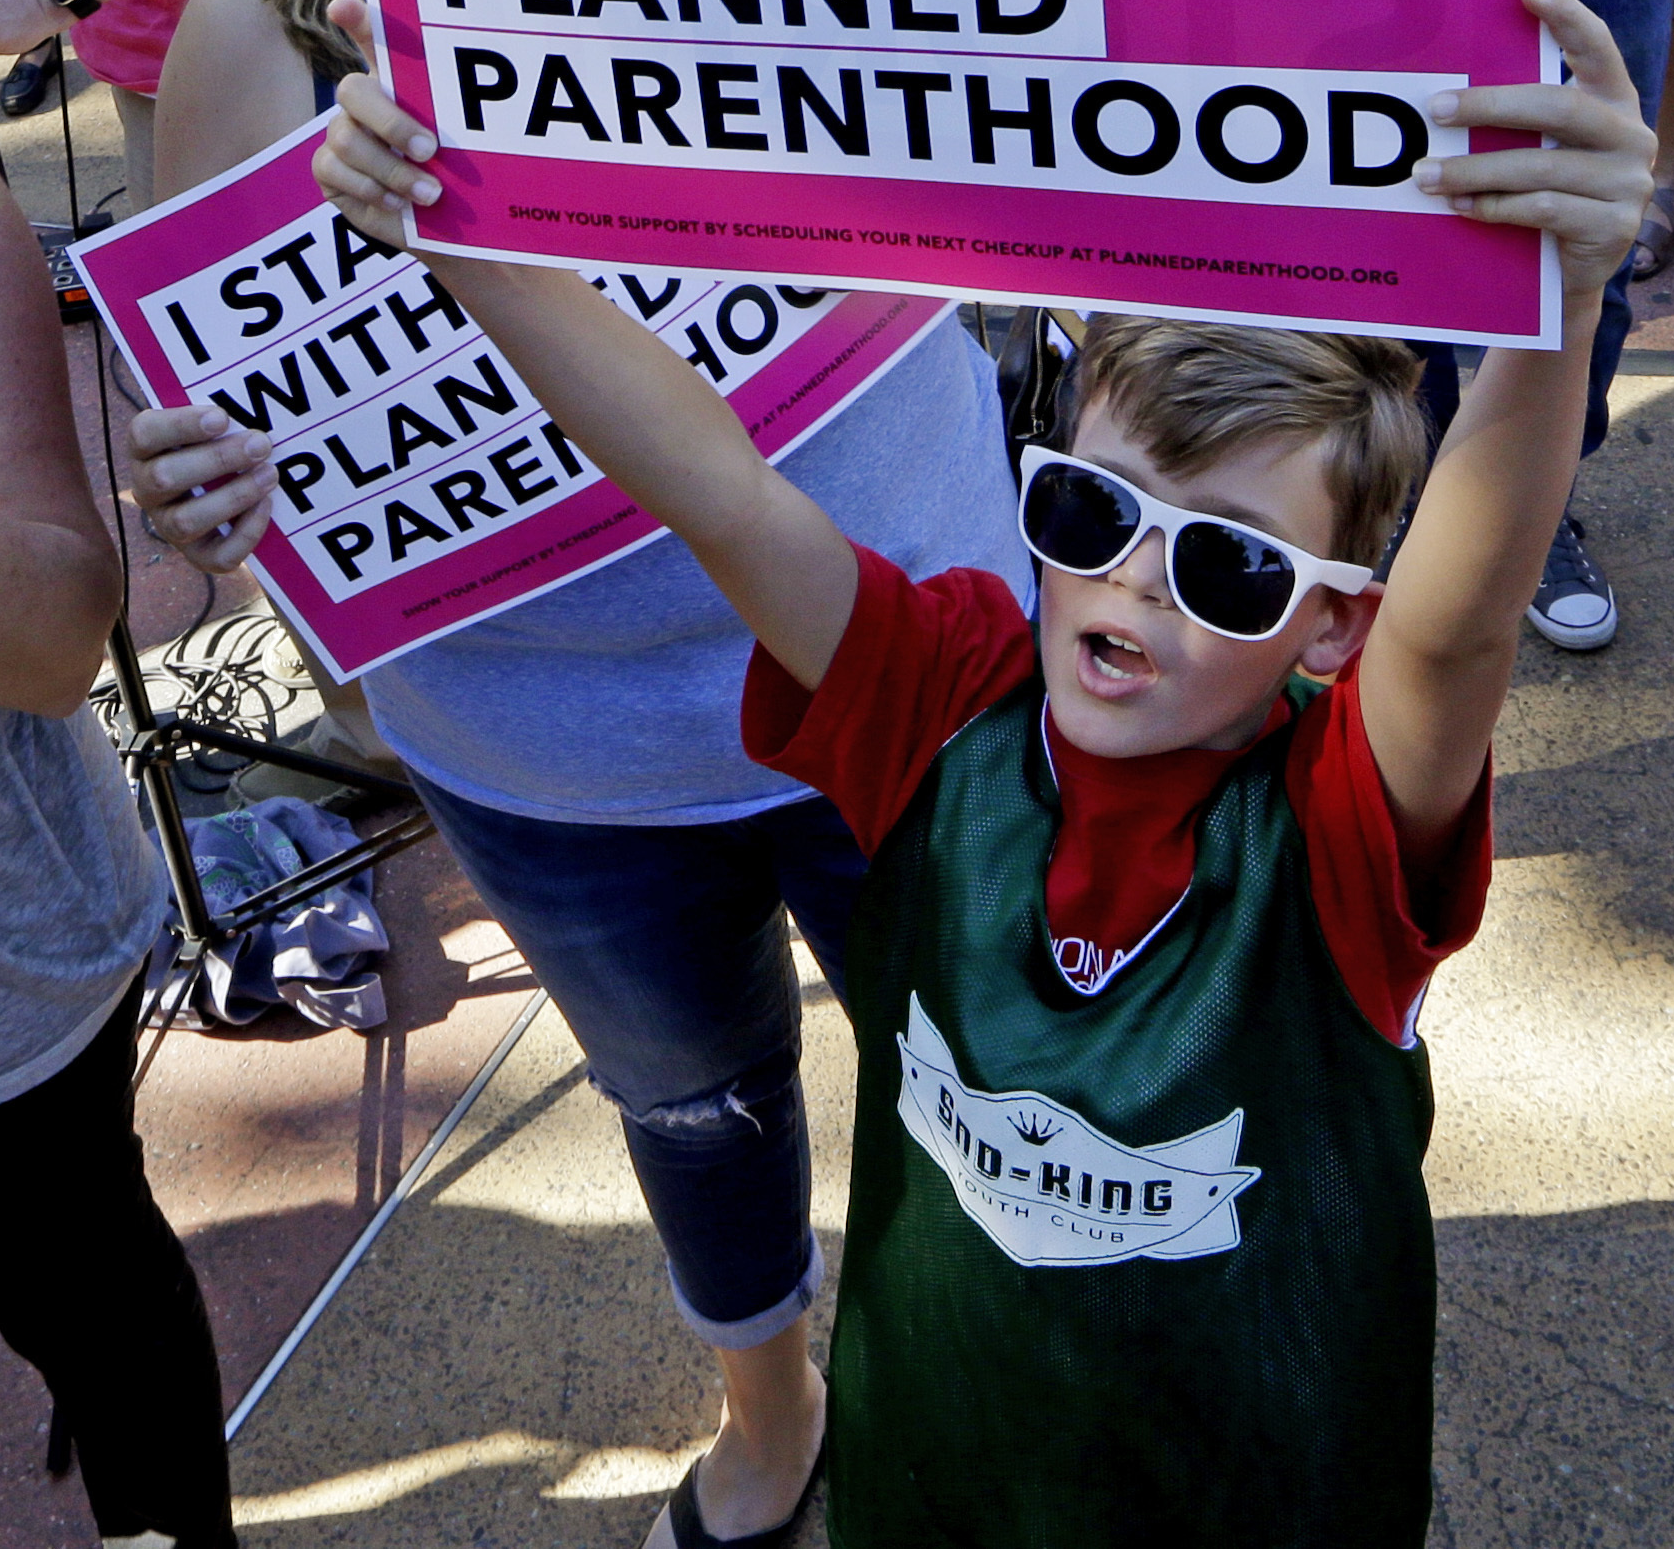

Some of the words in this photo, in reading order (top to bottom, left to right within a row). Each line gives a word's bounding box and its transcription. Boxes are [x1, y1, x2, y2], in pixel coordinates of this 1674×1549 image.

[453, 45, 1430, 191] PARENTHOOD
[508, 204, 562, 223] SHOW
[565, 210, 615, 229] YOUR
[618, 215, 701, 236] SUPPORT
[704, 220, 727, 238] BY
[732, 222, 853, 245] SCHEDULING
[857, 228, 913, 248] YOUR
[917, 233, 967, 253] NEXT
[971, 238, 1065, 260] CHECKUP
[1070, 246, 1093, 263] AT
[1098, 248, 1400, 286] PLANNEDPARENTHOOD.ORG
[164, 301, 211, 365] I
[211, 272, 468, 433] WITH
[1051, 1214, 1127, 1245] CLUB
